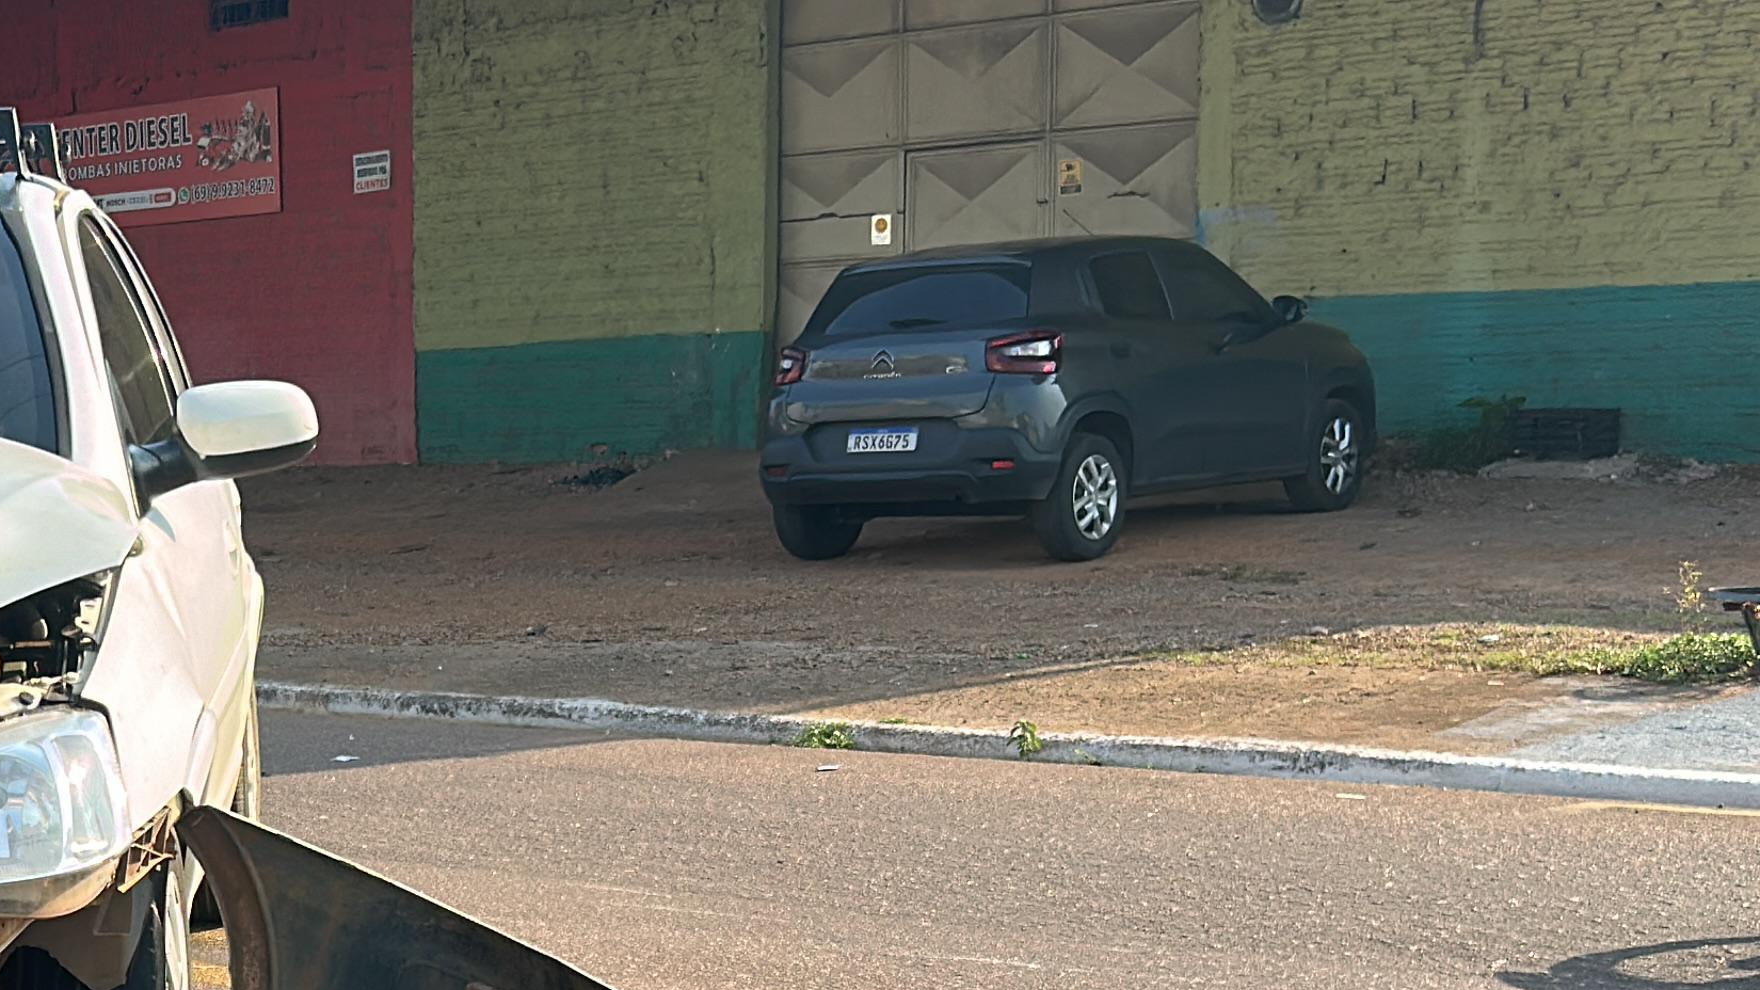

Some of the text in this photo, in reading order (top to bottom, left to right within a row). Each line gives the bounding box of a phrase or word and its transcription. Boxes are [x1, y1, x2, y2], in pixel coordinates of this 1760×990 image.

[55, 112, 192, 160] ENTER DIESEL
[114, 155, 182, 175] INIETORAS
[853, 434, 910, 450] RSX6G75
